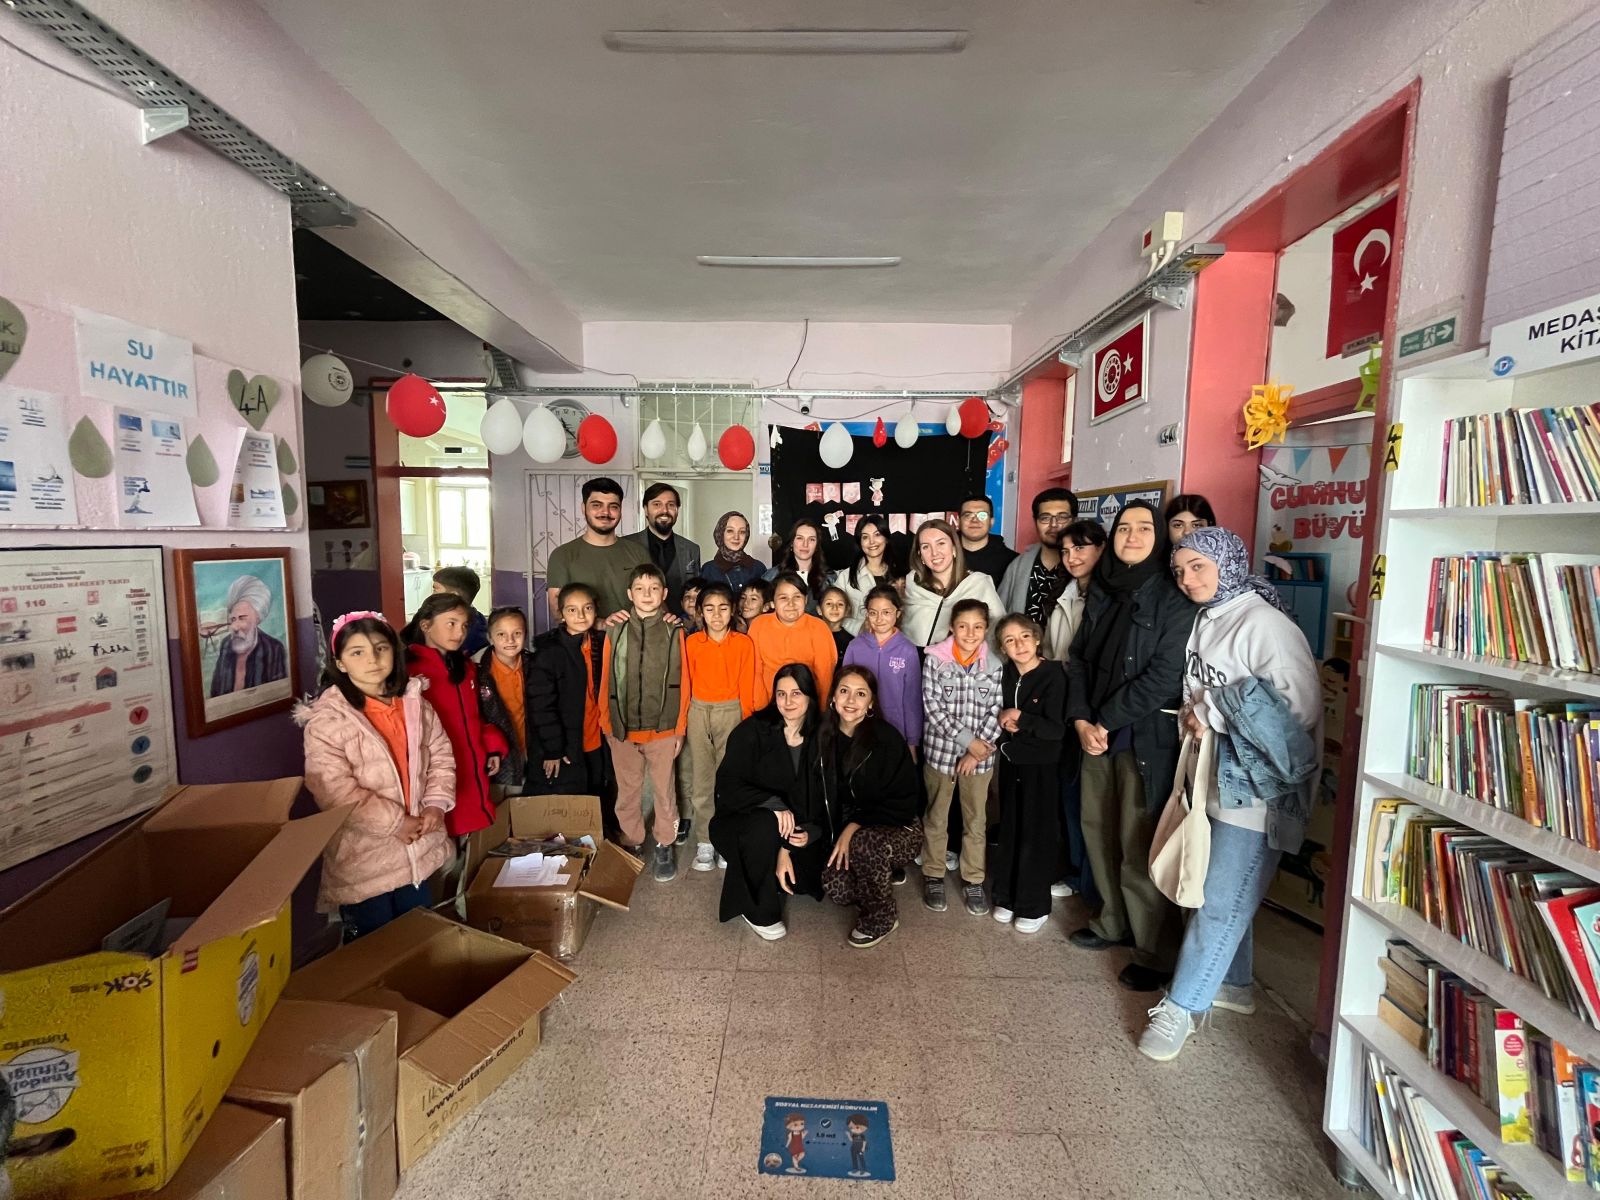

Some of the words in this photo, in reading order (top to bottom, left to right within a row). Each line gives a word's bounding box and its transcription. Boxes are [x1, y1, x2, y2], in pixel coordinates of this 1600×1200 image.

[1529, 306, 1600, 340] MEDA
[127, 339, 153, 360] SU
[90, 362, 188, 399] HAYATTIR
[239, 384, 269, 415] 4-A
[25, 599, 46, 608] 110
